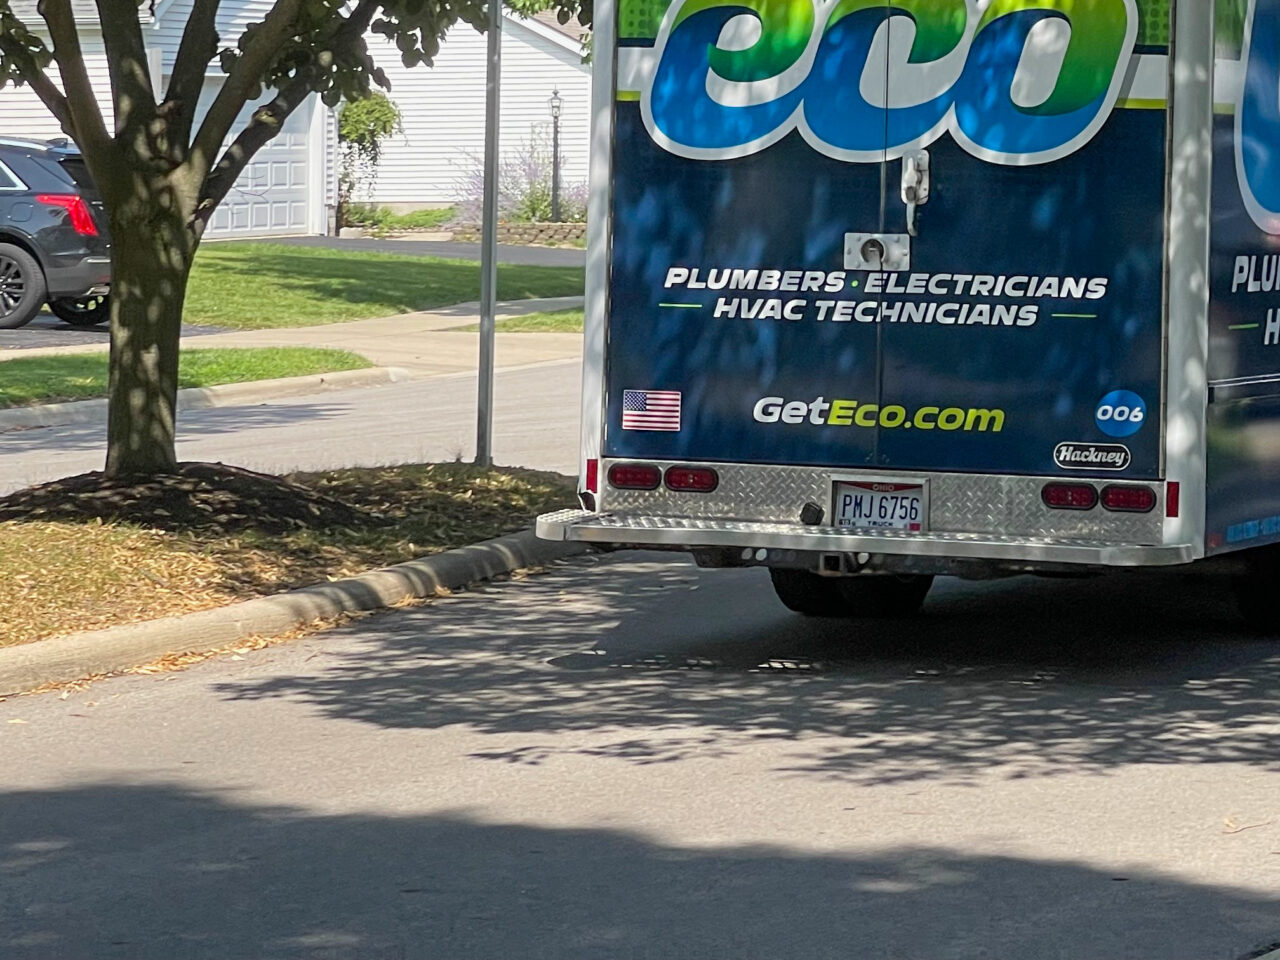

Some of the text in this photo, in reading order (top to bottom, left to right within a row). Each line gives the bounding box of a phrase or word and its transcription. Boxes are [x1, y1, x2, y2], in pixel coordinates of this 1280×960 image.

[664, 267, 1108, 299] PLUMBERS ELECTRICIANS
[713, 297, 1039, 327] HVAC TECHNICIANS
[753, 396, 1005, 432] GetEco.com
[1097, 405, 1144, 422] 006
[1059, 446, 1126, 467] Hackney
[872, 484, 894, 492] OHIO
[842, 494, 920, 521] PMJ 6756
